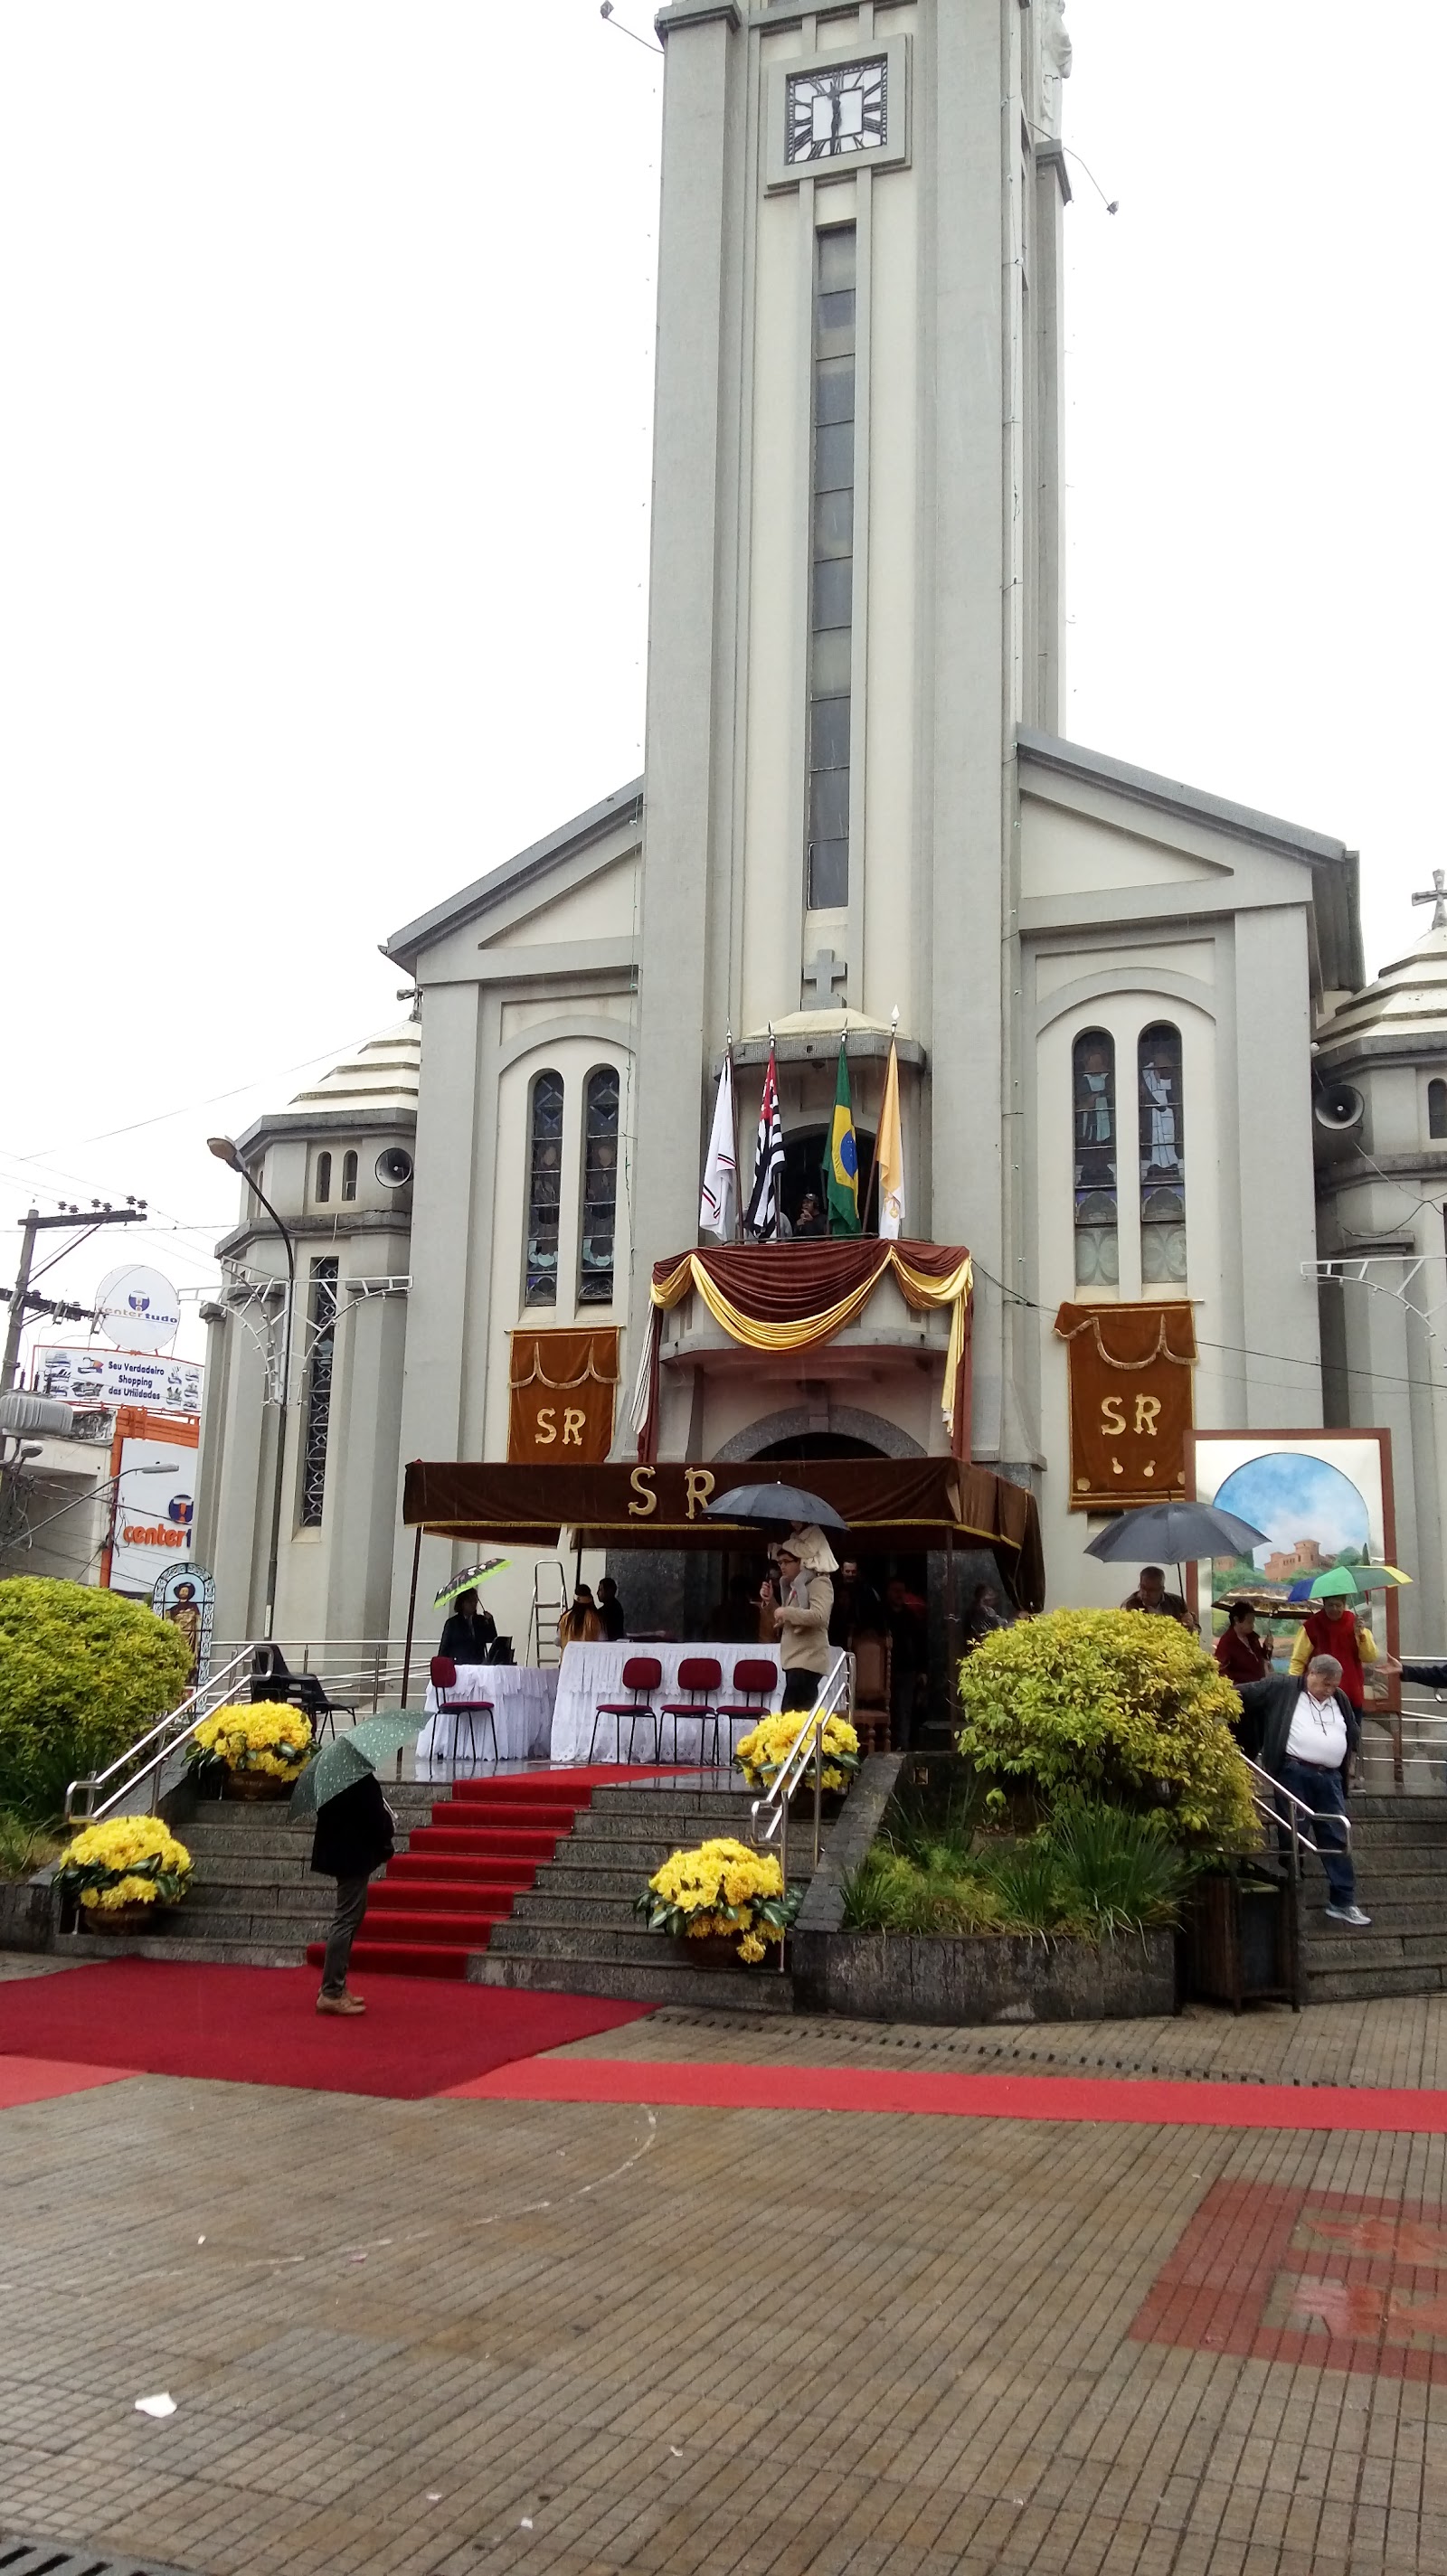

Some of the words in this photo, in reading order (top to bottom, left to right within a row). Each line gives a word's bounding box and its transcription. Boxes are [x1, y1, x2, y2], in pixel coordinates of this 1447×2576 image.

[108, 1361, 122, 1371] Seu
[124, 1363, 165, 1375] Verdadeiro
[118, 1374, 153, 1389] Shopping
[108, 1386, 121, 1396] das
[1101, 1393, 1161, 1436] SR
[534, 1407, 586, 1446] SR
